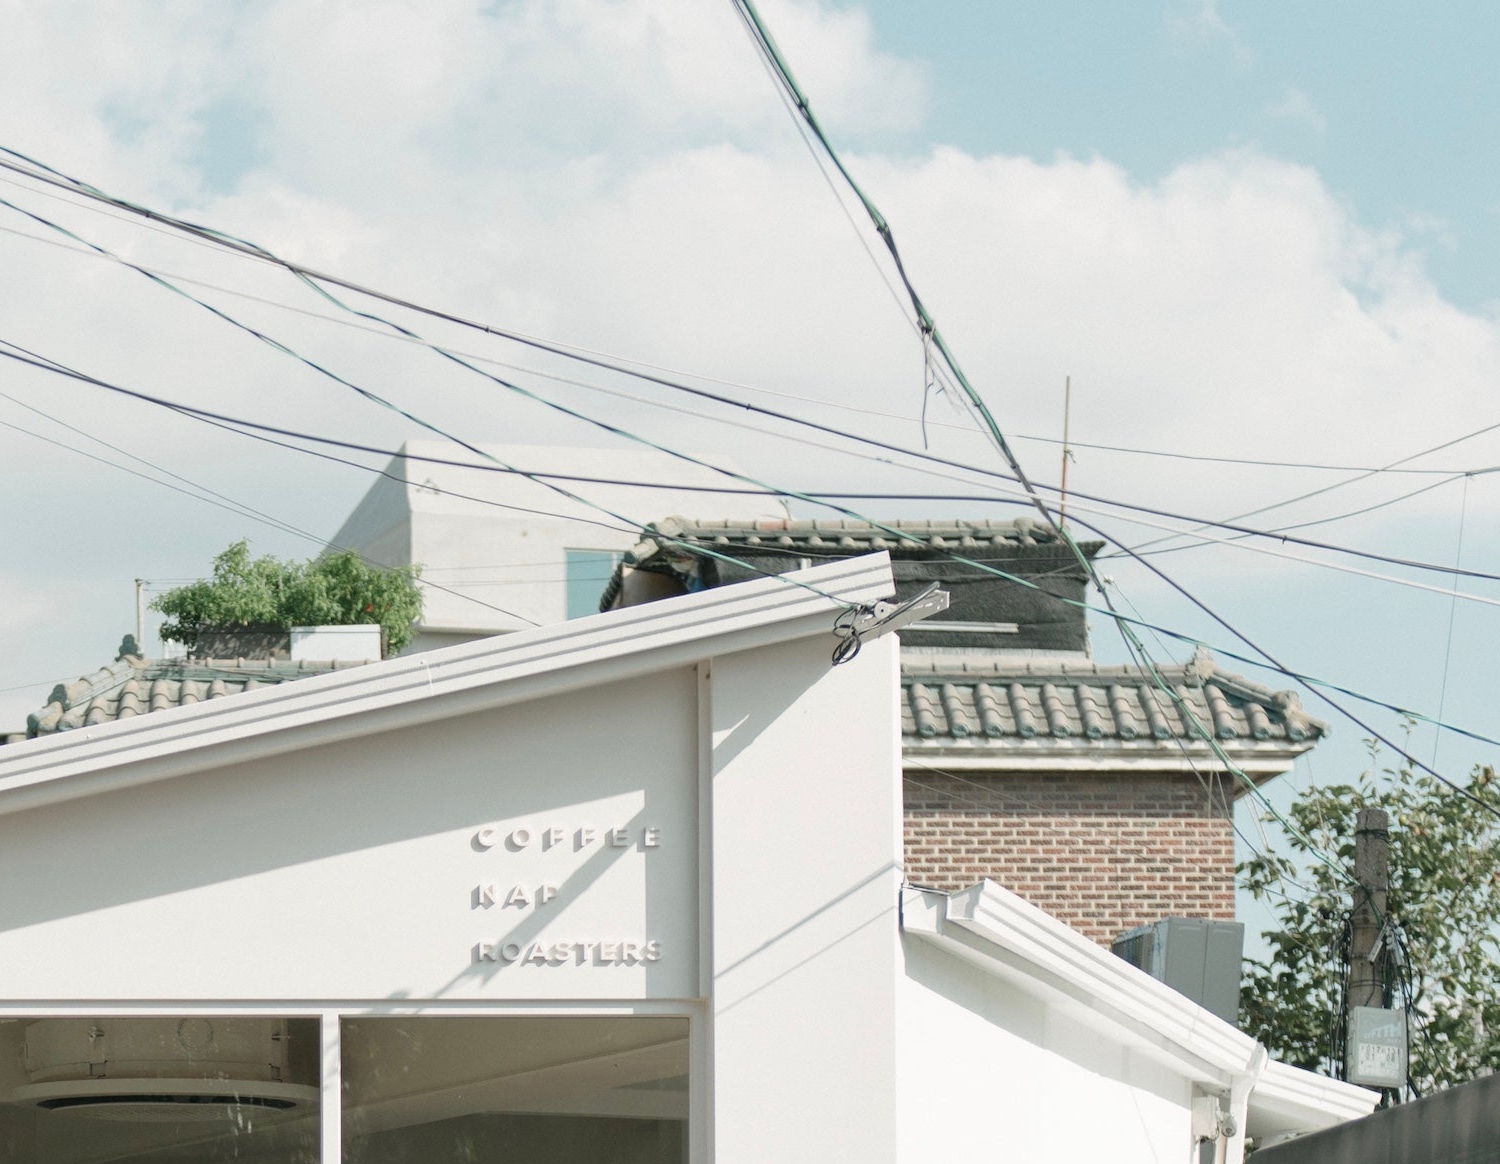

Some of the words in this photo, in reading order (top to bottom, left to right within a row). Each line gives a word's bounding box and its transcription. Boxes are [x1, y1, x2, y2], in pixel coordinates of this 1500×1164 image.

[473, 826, 660, 850] COFFEE
[474, 881, 559, 906] NAP
[473, 940, 662, 964] ROASTERS
